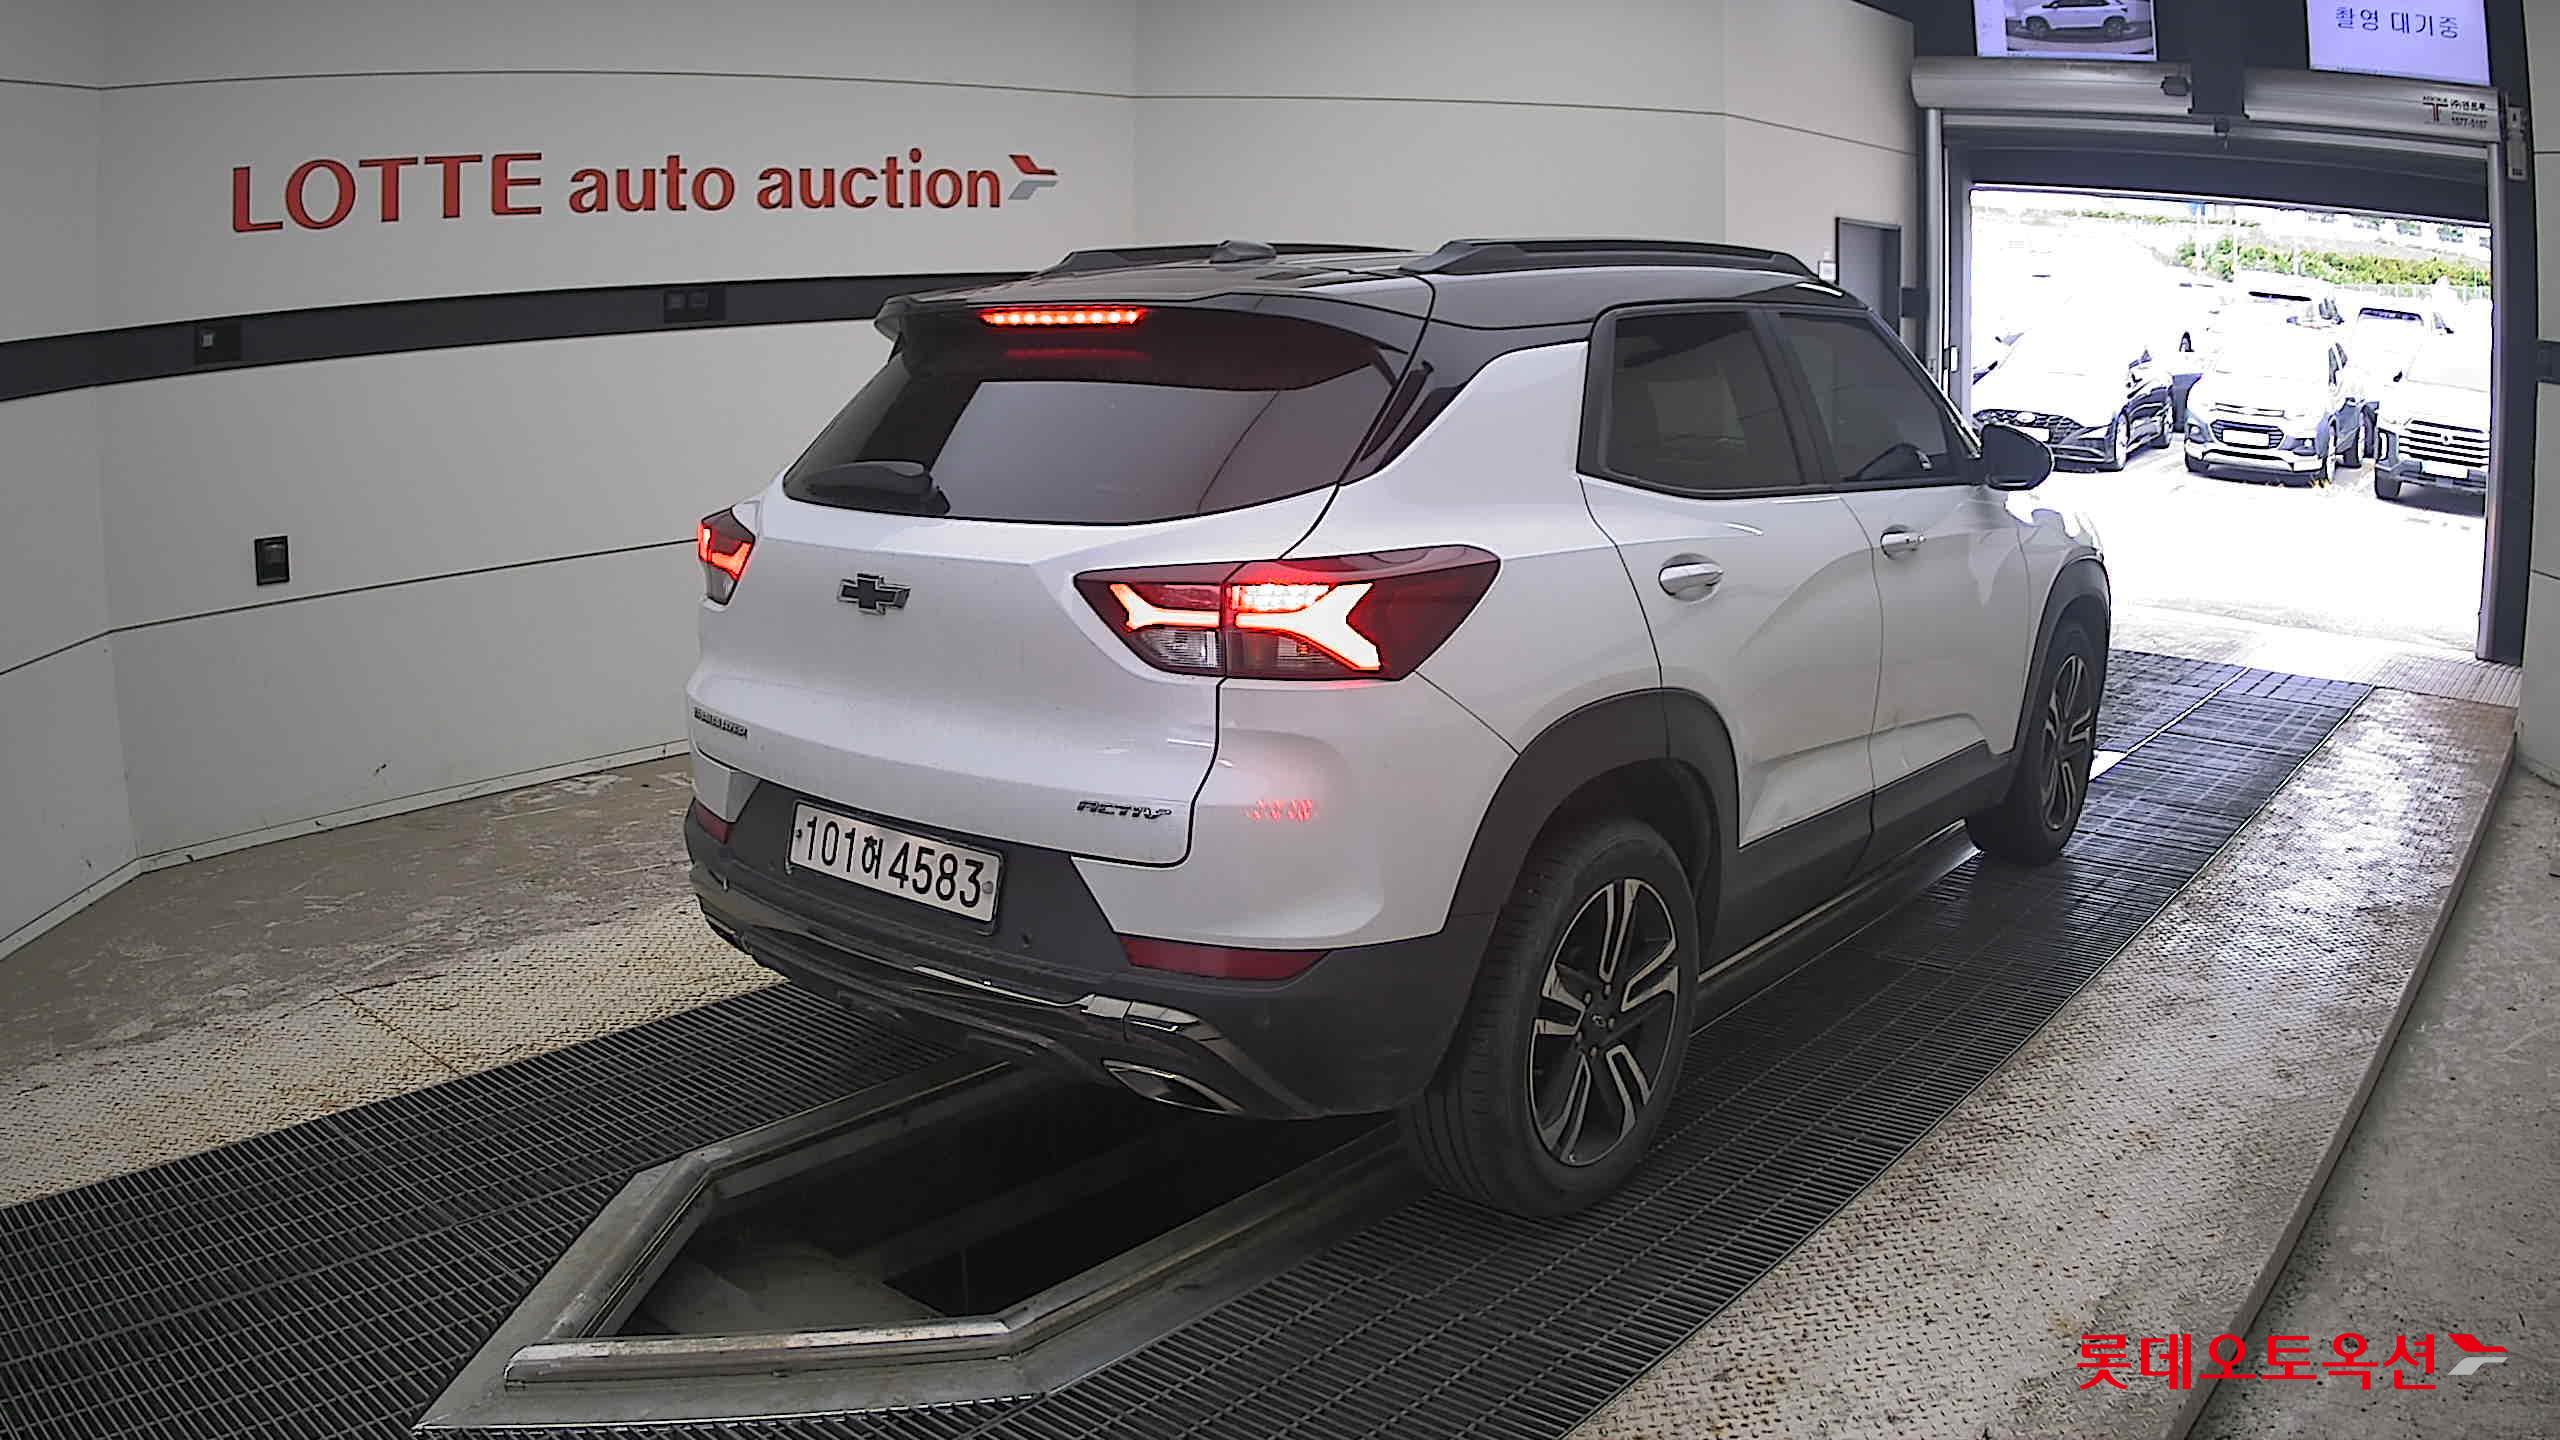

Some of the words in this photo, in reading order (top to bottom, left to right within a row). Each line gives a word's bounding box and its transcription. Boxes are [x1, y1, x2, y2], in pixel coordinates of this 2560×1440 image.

[2335, 6, 2379, 32] 촬영
[2391, 11, 2459, 40] 대기중
[232, 152, 542, 233] LOTTE
[568, 154, 736, 214] auto
[757, 147, 1001, 212] auction
